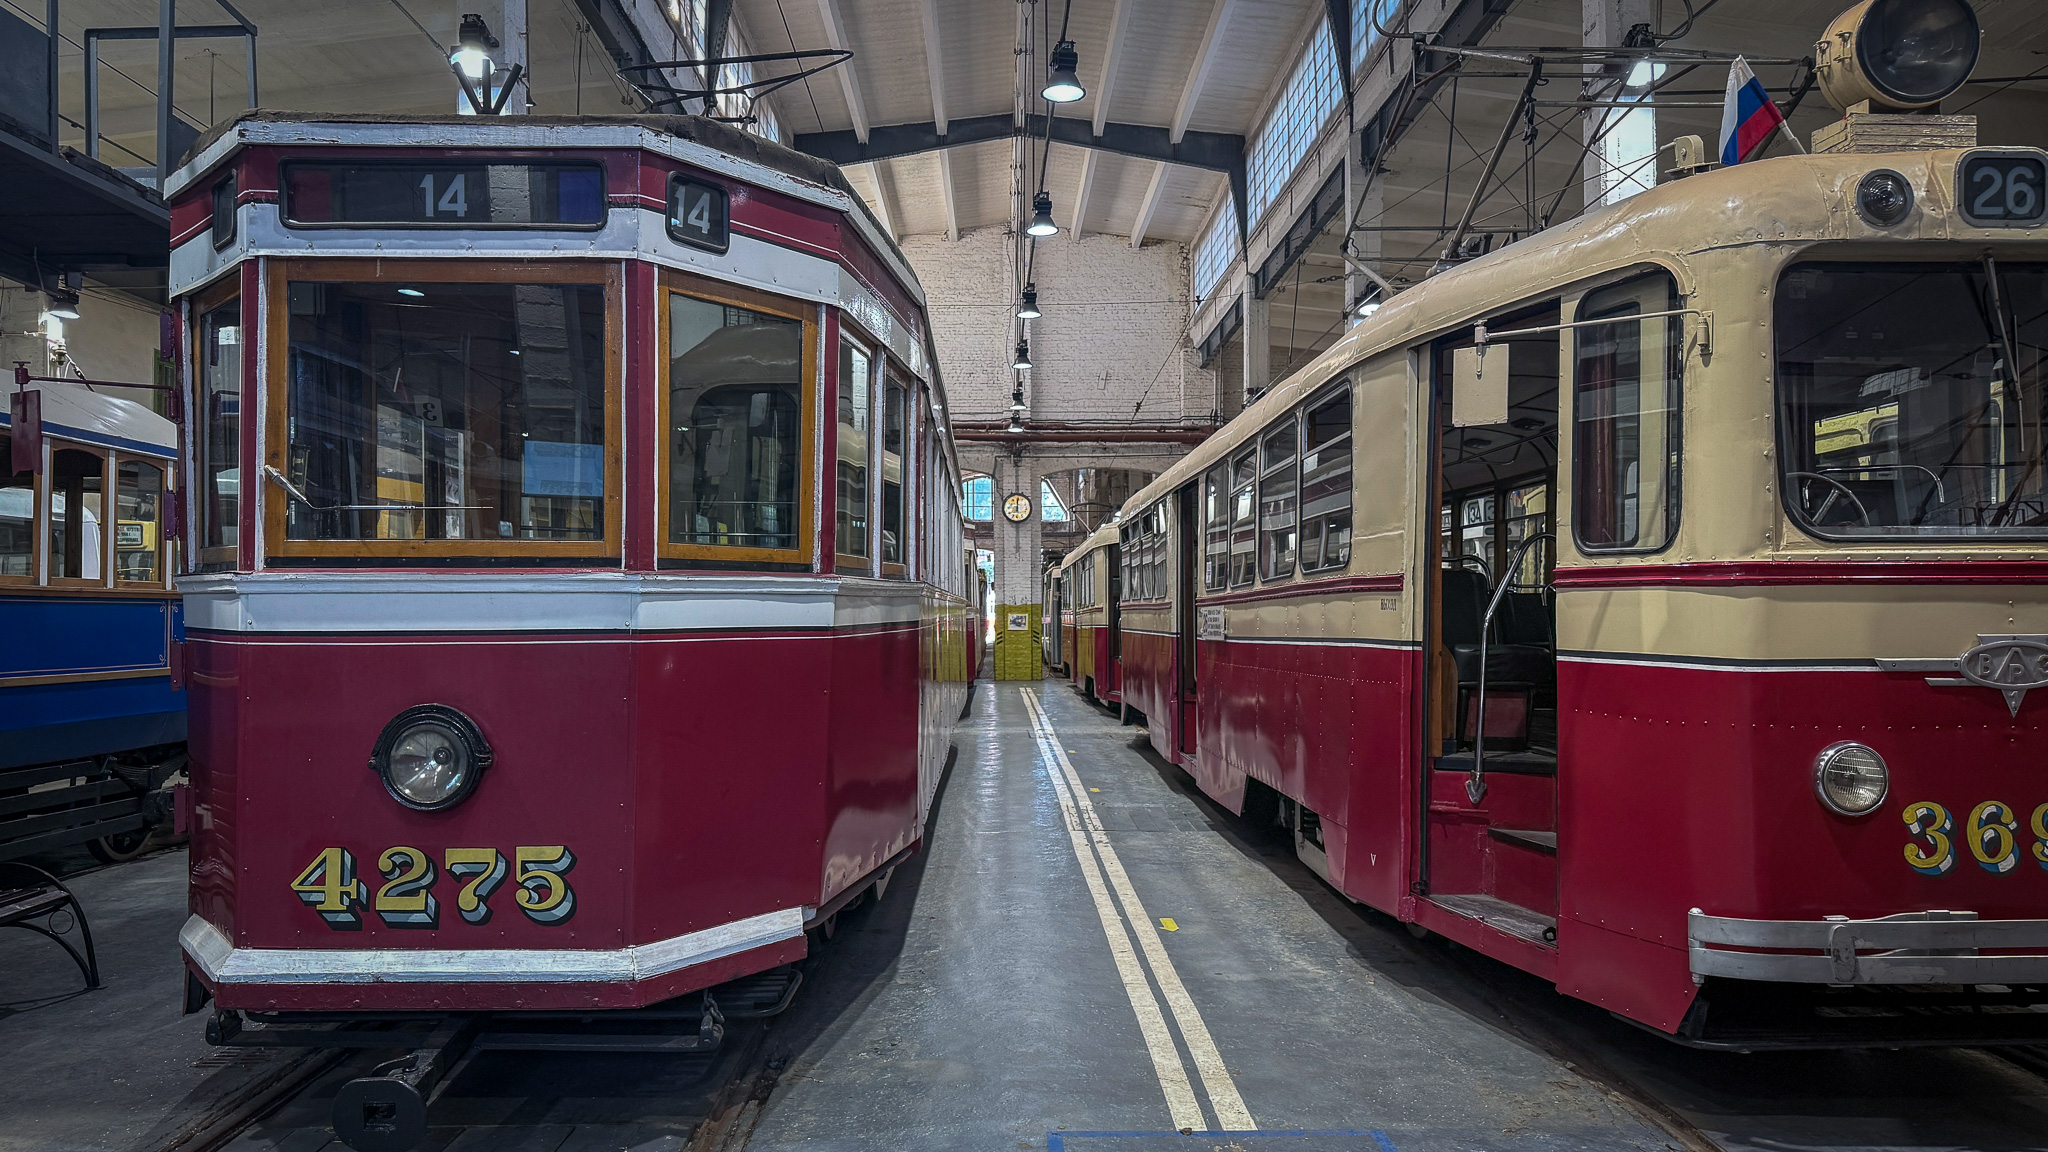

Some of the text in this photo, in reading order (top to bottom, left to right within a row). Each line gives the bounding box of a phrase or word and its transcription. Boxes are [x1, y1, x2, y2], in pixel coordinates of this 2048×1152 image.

[419, 173, 468, 217] 14
[674, 185, 711, 235] 14
[1973, 166, 2036, 215] 26
[290, 846, 577, 931] 4275
